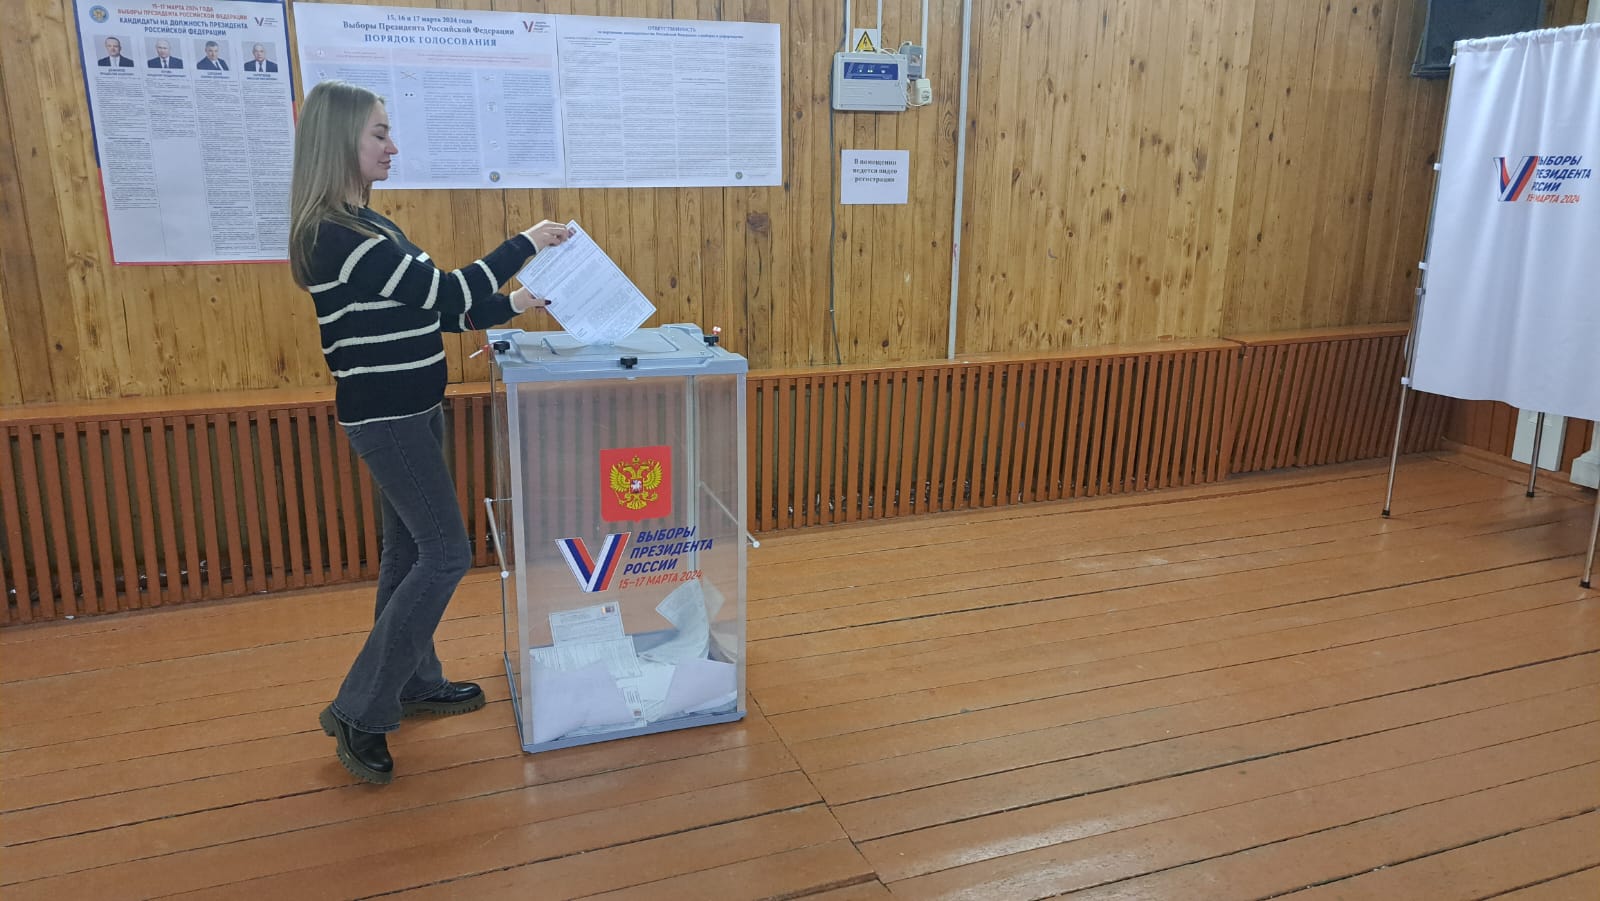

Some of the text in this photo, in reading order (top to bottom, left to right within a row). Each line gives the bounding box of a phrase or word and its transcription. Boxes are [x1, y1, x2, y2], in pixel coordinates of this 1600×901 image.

[144, 26, 186, 34] РОССИЙСКОЙ
[342, 20, 514, 36] Выборы Президента Российской Федерации
[364, 34, 496, 46] ПОРЯДОК ГОЛОСОВАНИЯ
[1560, 195, 1580, 203] 2024
[636, 526, 696, 544] ВЫБОРЫ
[630, 538, 713, 559] ПРЕЗИДЕНТА
[624, 558, 678, 575] РОССИИ
[647, 572, 678, 586] МАРТА
[680, 570, 702, 582] 2024
